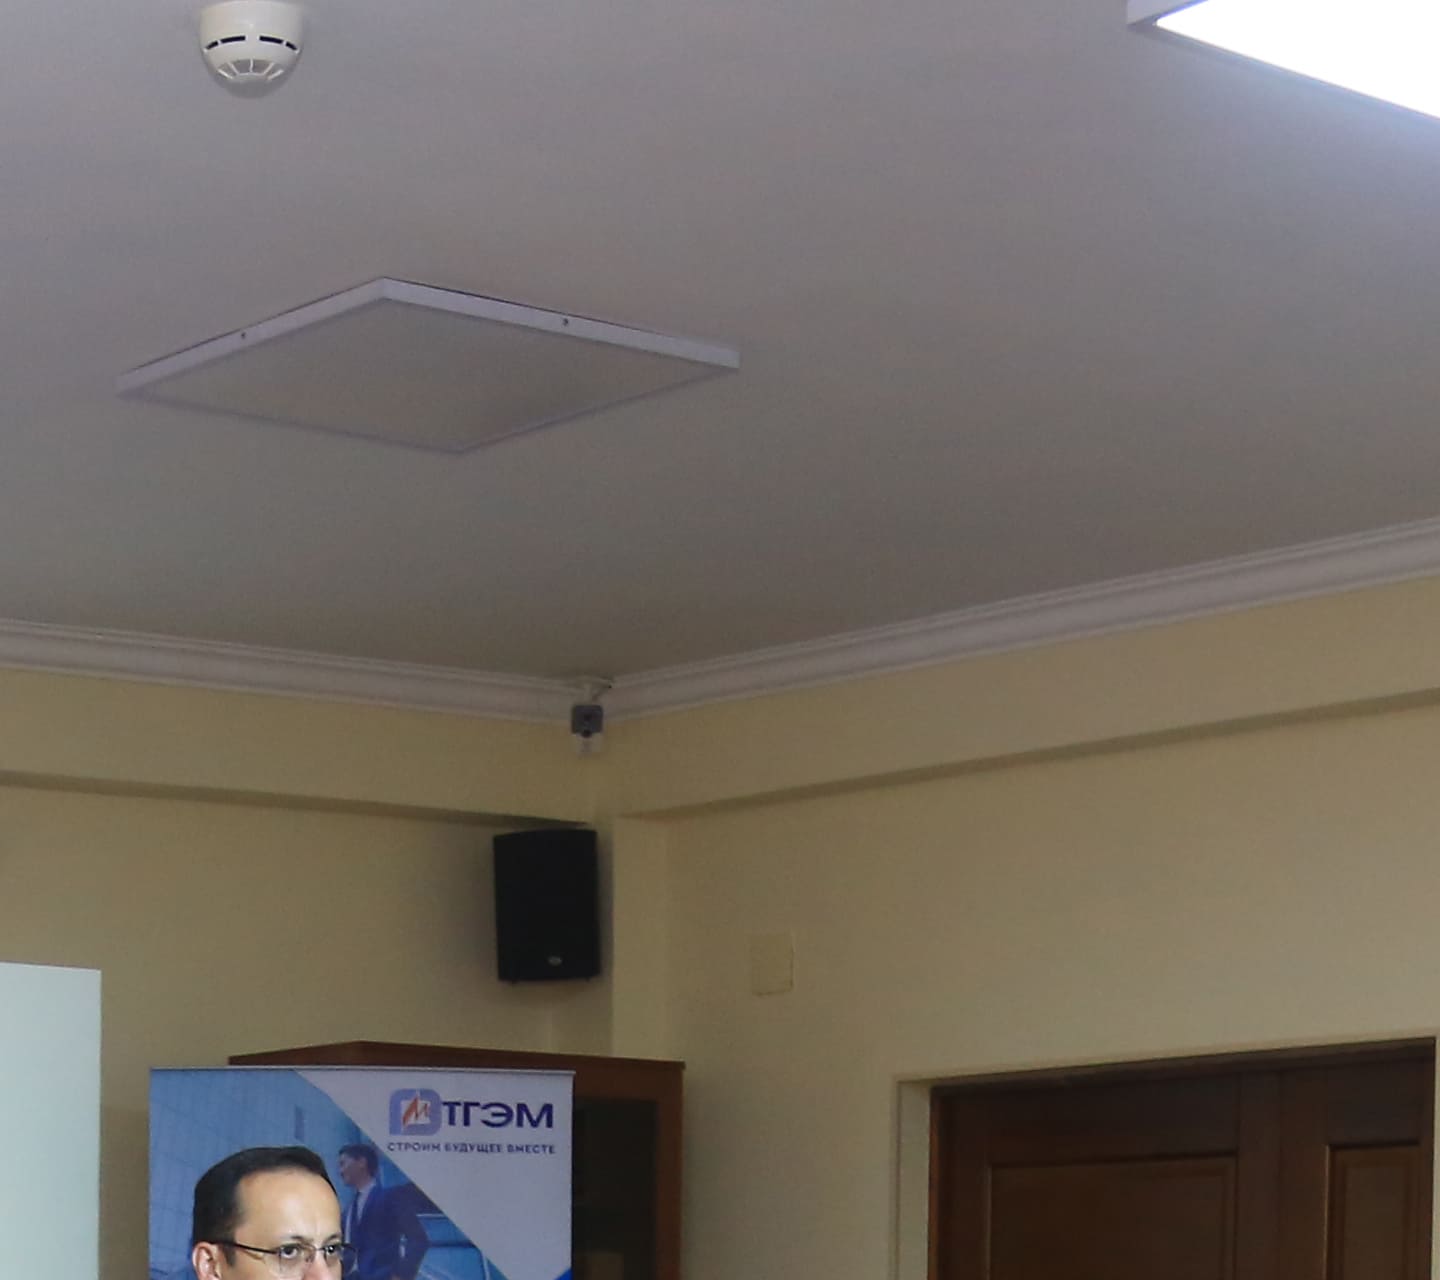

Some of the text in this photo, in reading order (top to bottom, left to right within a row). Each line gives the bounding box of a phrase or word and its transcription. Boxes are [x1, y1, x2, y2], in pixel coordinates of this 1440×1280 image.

[442, 1101, 554, 1128] ТГЭМ
[387, 1142, 556, 1155] СТРОИМ БУДУЩЕЕ ВМЕСТЕ
